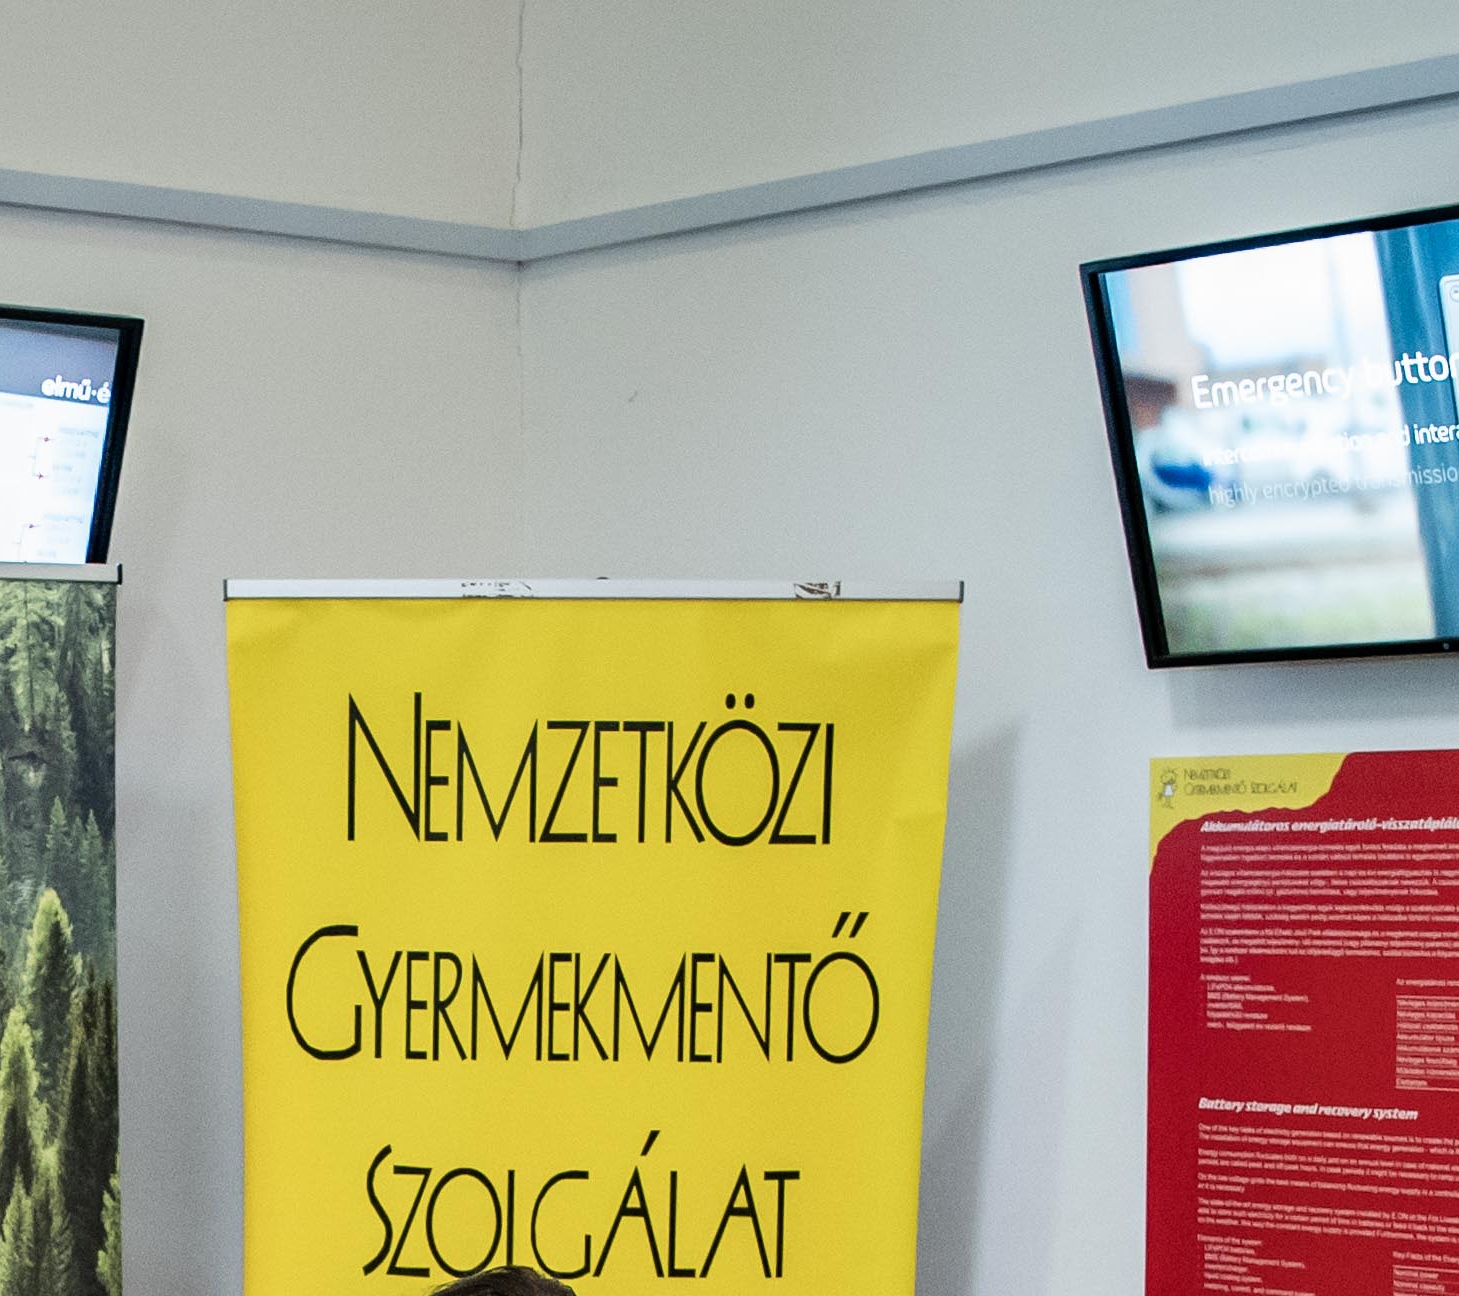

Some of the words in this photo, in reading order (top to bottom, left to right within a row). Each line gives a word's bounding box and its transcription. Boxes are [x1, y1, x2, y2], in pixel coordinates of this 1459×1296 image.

[1190, 366, 1355, 409] Emergency
[1207, 483, 1258, 508] highly
[1262, 475, 1350, 503] encrypted
[347, 692, 835, 846] NEMZETKÖZI
[286, 911, 880, 1064] GYERMEKMENTŐ
[1198, 1096, 1245, 1113] Battery
[1245, 1100, 1292, 1116] storage
[1292, 1103, 1319, 1116] and
[1318, 1105, 1372, 1120] recovery
[1372, 1108, 1419, 1121] system
[362, 1130, 801, 1280] SZOLGÁLAT
